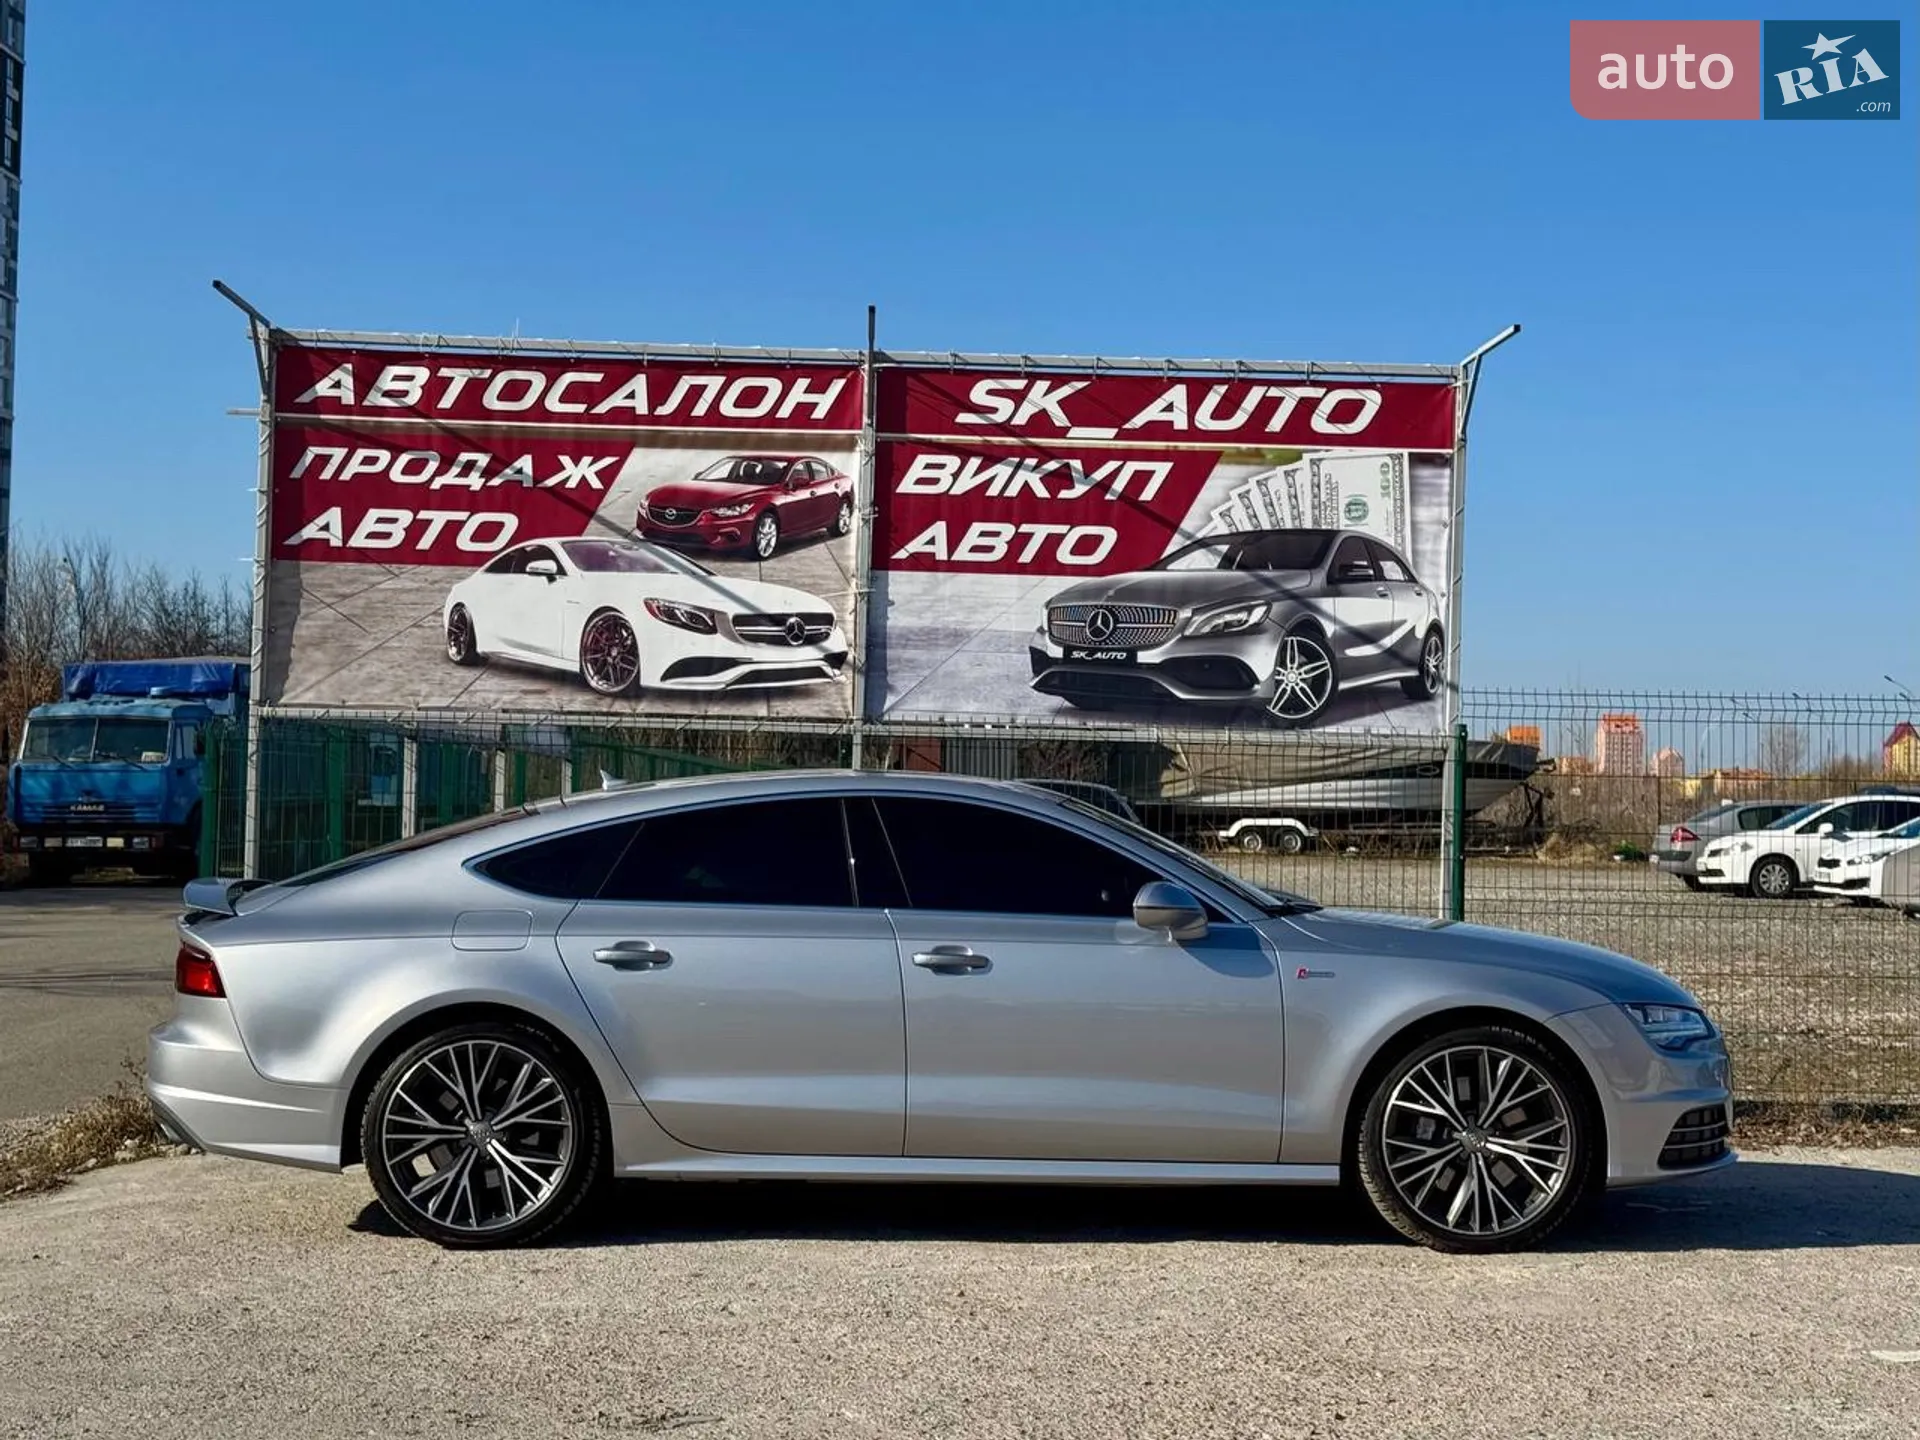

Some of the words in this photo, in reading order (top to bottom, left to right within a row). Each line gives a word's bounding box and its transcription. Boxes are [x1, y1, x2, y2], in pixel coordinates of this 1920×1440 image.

[295, 363, 846, 420] АВТОСАЛОН
[955, 378, 1383, 439] SK_AUTO
[290, 446, 619, 491] ПРОДАЖ
[896, 454, 1174, 501] ВИКУП
[283, 506, 518, 552] АВТО
[891, 521, 1118, 565] АВТО
[1070, 651, 1127, 660] SK_AUTO
